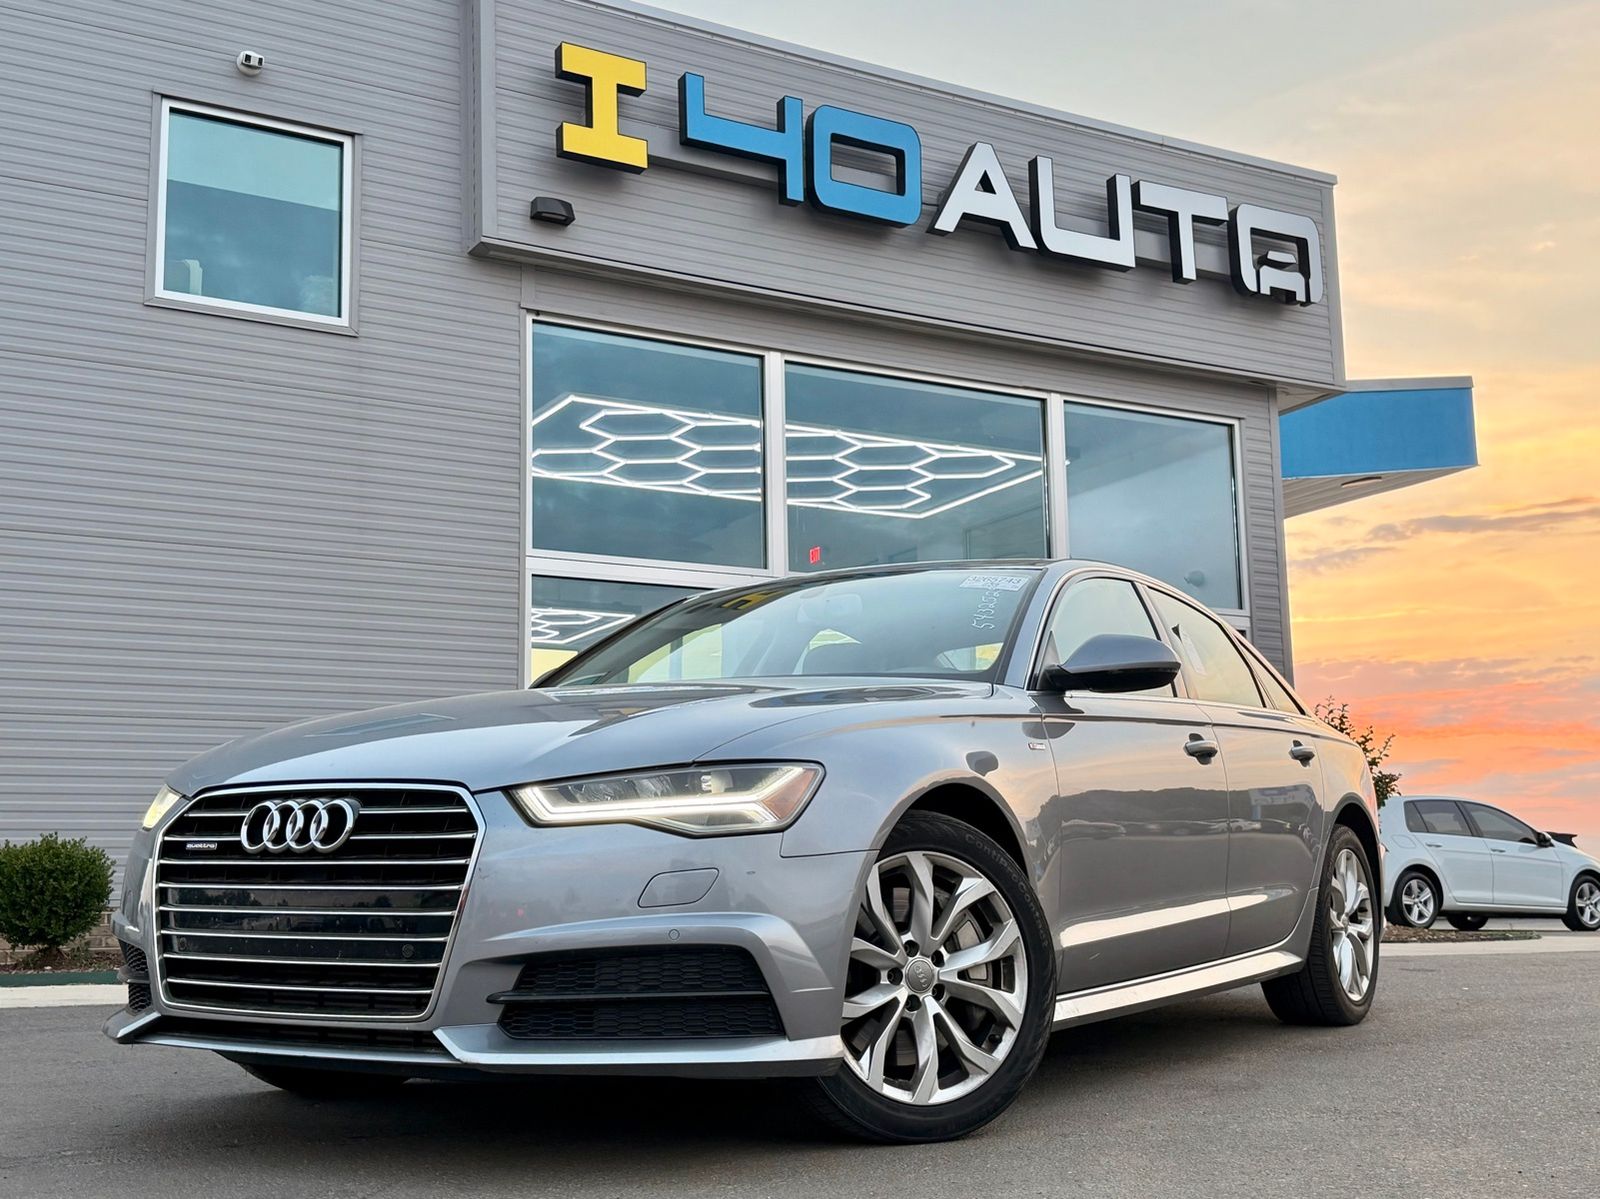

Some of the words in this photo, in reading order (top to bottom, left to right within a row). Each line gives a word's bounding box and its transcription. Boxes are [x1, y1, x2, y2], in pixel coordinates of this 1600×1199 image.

[556, 41, 648, 174] I
[679, 71, 922, 227] 40
[927, 141, 1323, 306] AUTO
